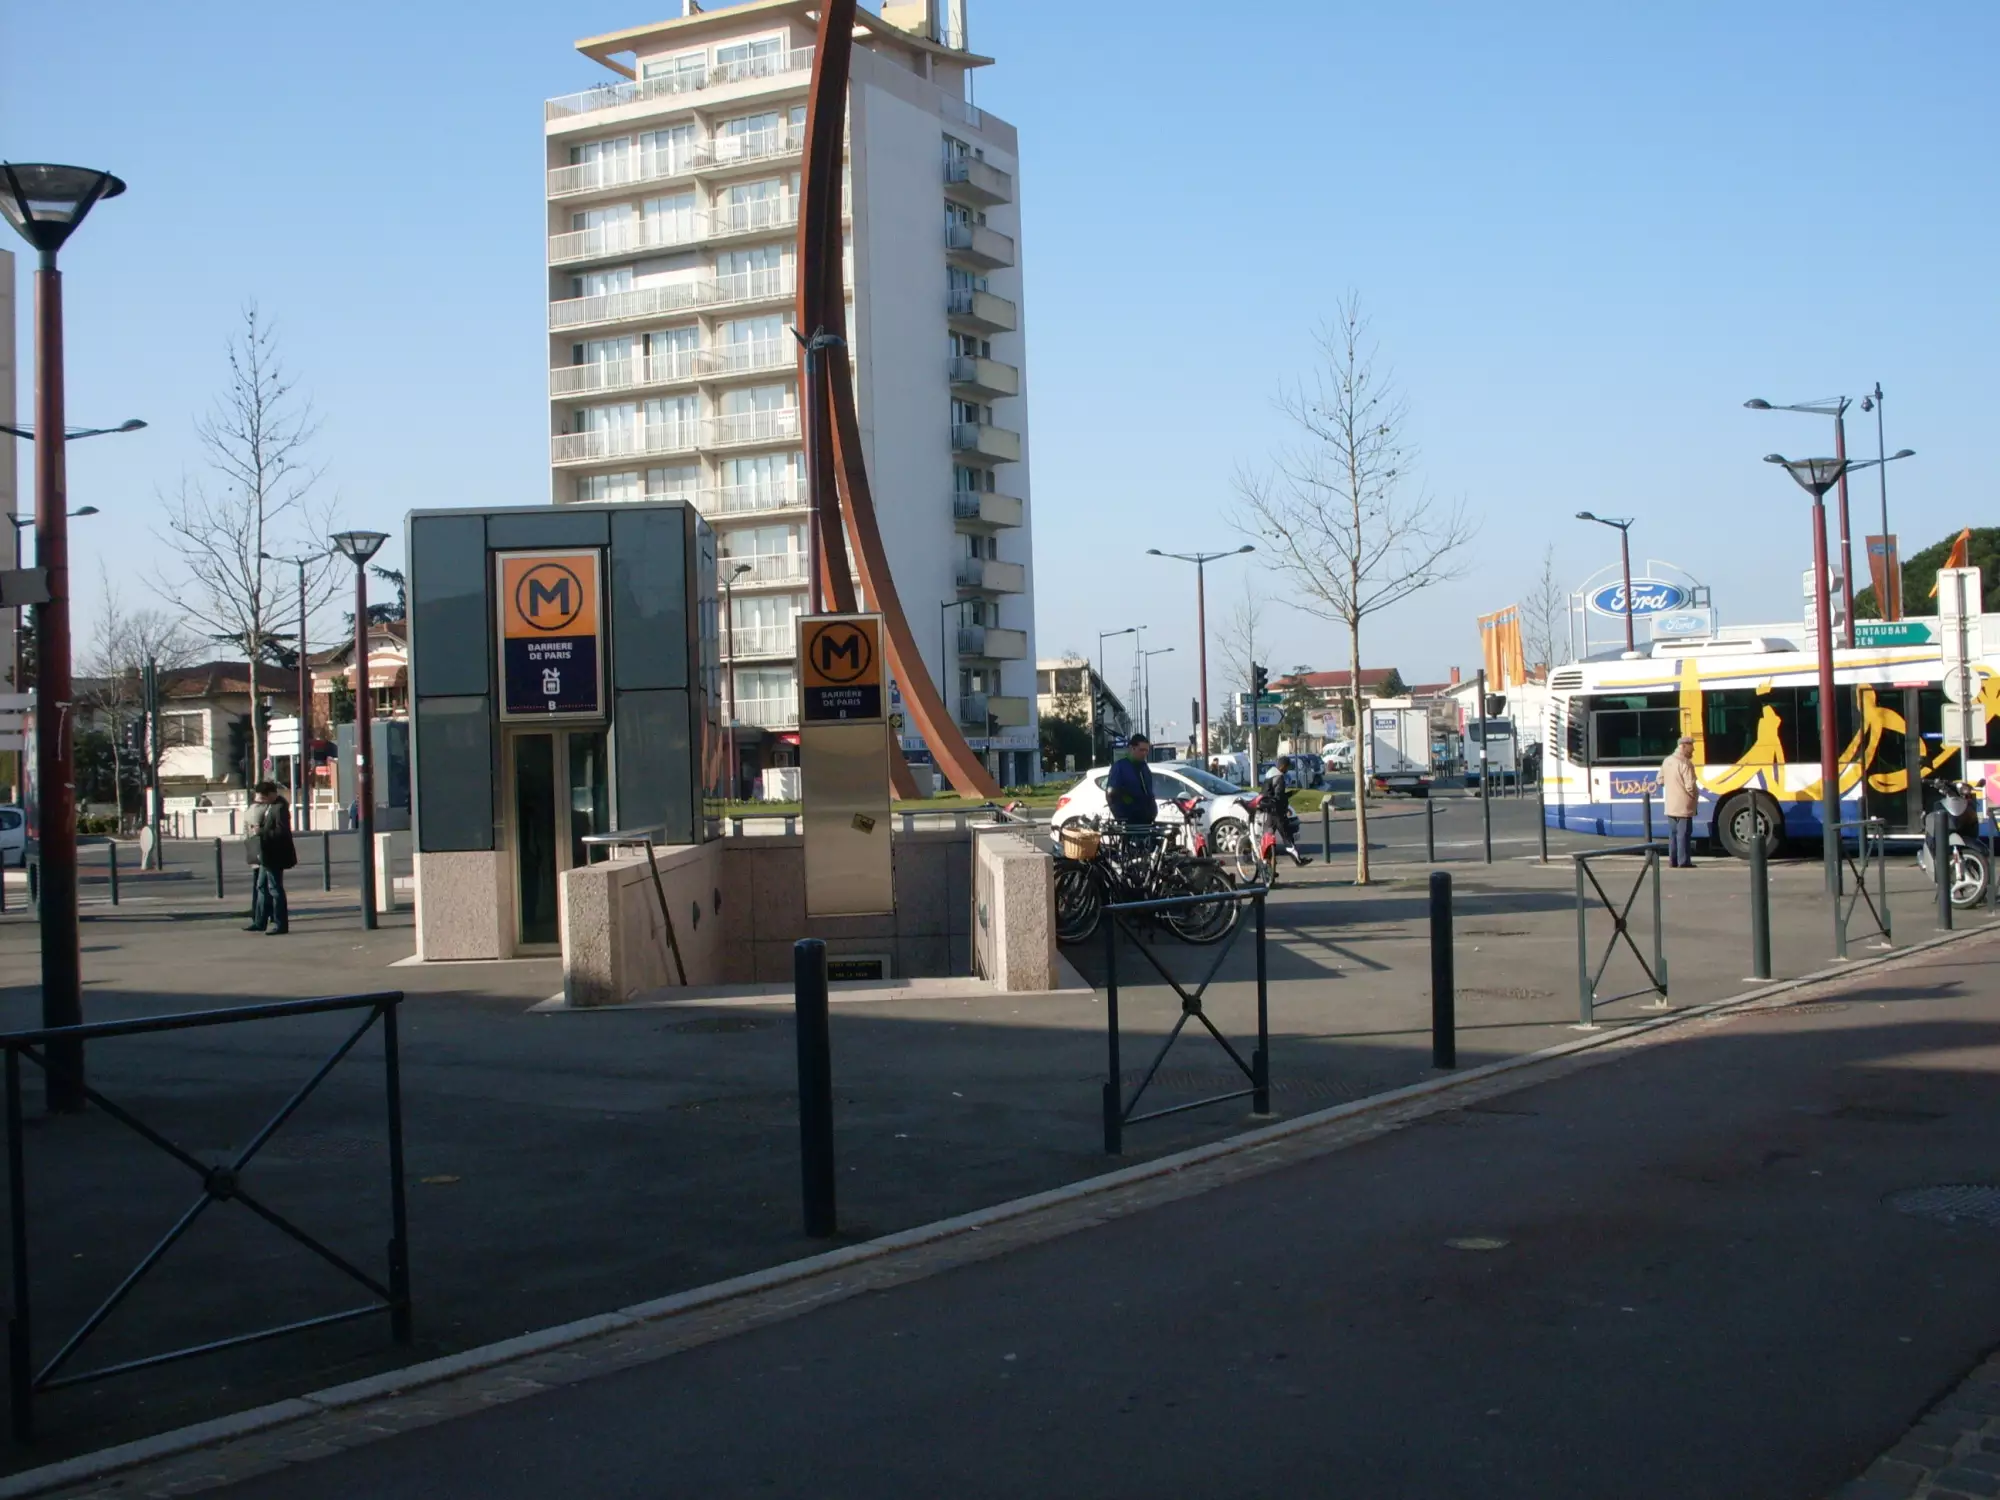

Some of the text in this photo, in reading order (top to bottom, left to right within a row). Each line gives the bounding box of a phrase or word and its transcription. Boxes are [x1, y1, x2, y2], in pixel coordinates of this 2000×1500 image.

[529, 577, 570, 616] M
[1610, 585, 1668, 610] Ford
[1666, 617, 1697, 631] Ford
[1855, 626, 1908, 636] ONTAUBAN
[529, 651, 572, 660] DE PARIS
[821, 635, 860, 670] M
[548, 700, 557, 710] B
[823, 698, 861, 707] DE PARIS
